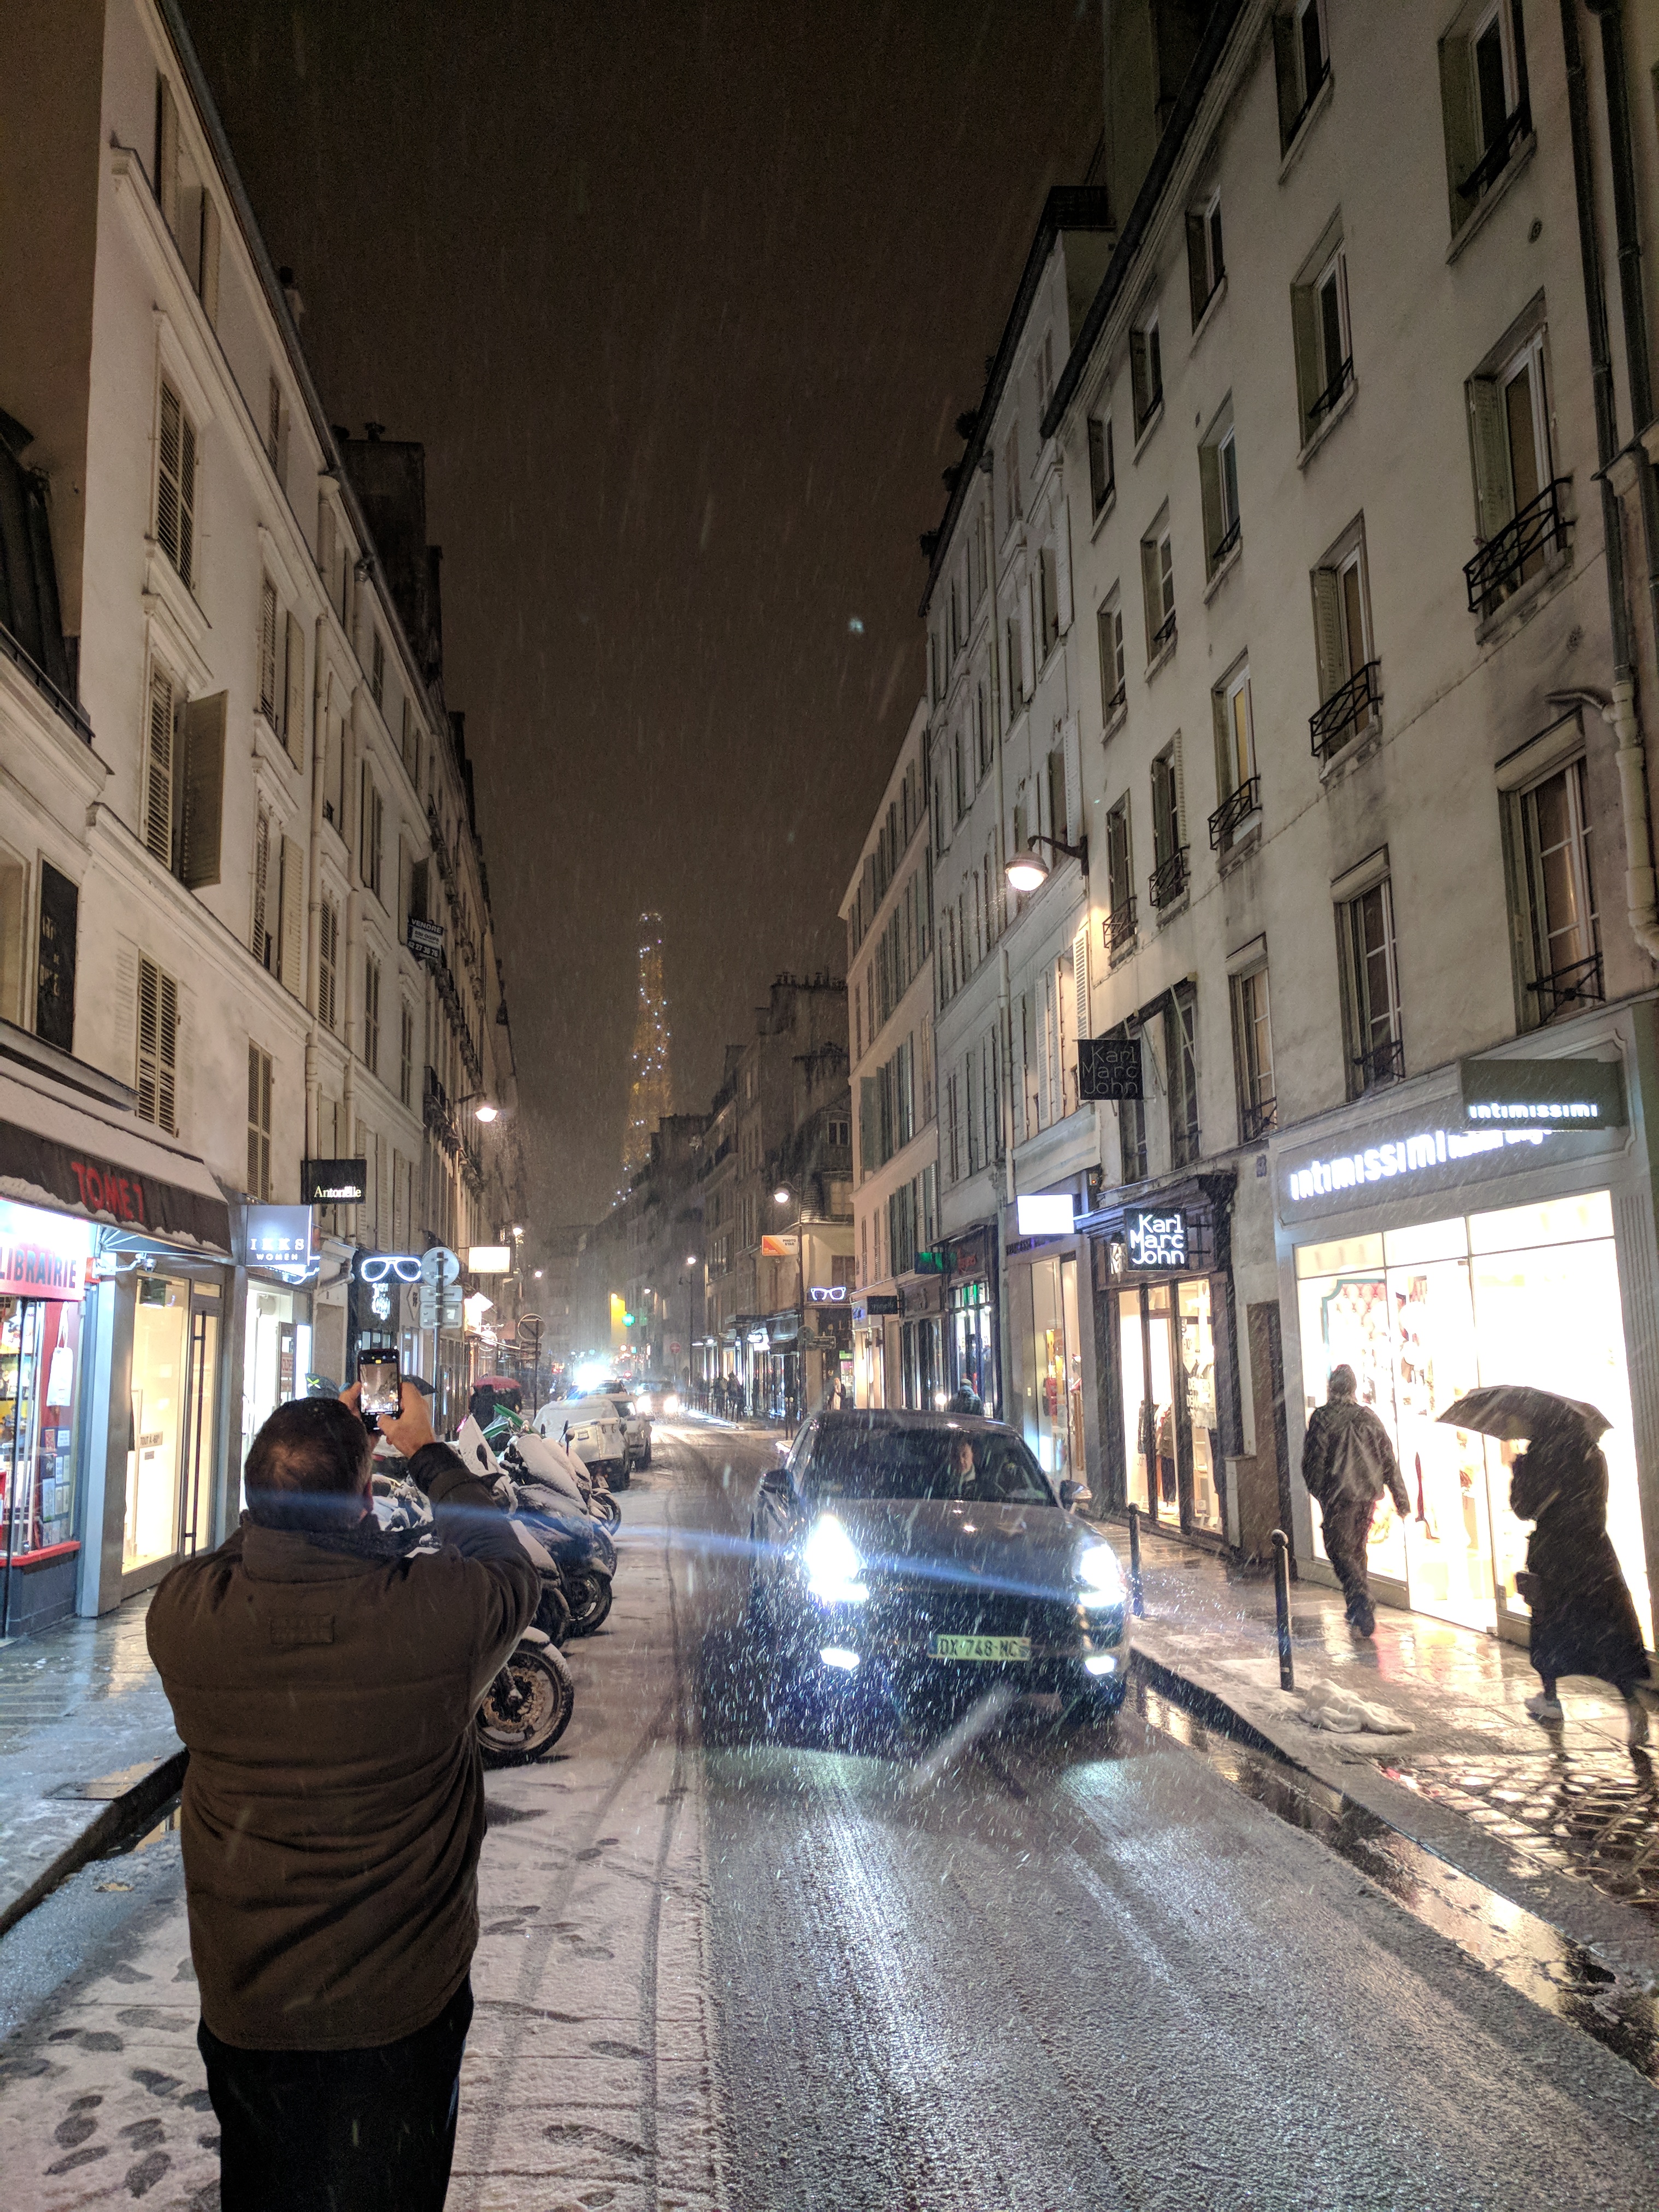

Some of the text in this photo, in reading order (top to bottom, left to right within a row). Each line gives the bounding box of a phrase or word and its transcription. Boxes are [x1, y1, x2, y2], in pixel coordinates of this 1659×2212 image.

[411, 919, 442, 933] VENDRE
[1091, 1046, 1138, 1063] Karl
[1083, 1061, 1137, 1079] Marc
[1084, 1077, 1138, 1094] John
[1469, 1102, 1598, 1119] intimissimi
[1289, 1129, 1446, 1201] intimissimi
[314, 1185, 362, 1198] Antonelle
[1138, 1213, 1184, 1233] Karl
[250, 1238, 304, 1251] IKKS
[1129, 1229, 1184, 1249] Marc
[1132, 1245, 1185, 1264] John
[0, 1247, 77, 1289] LIBRAIRIE
